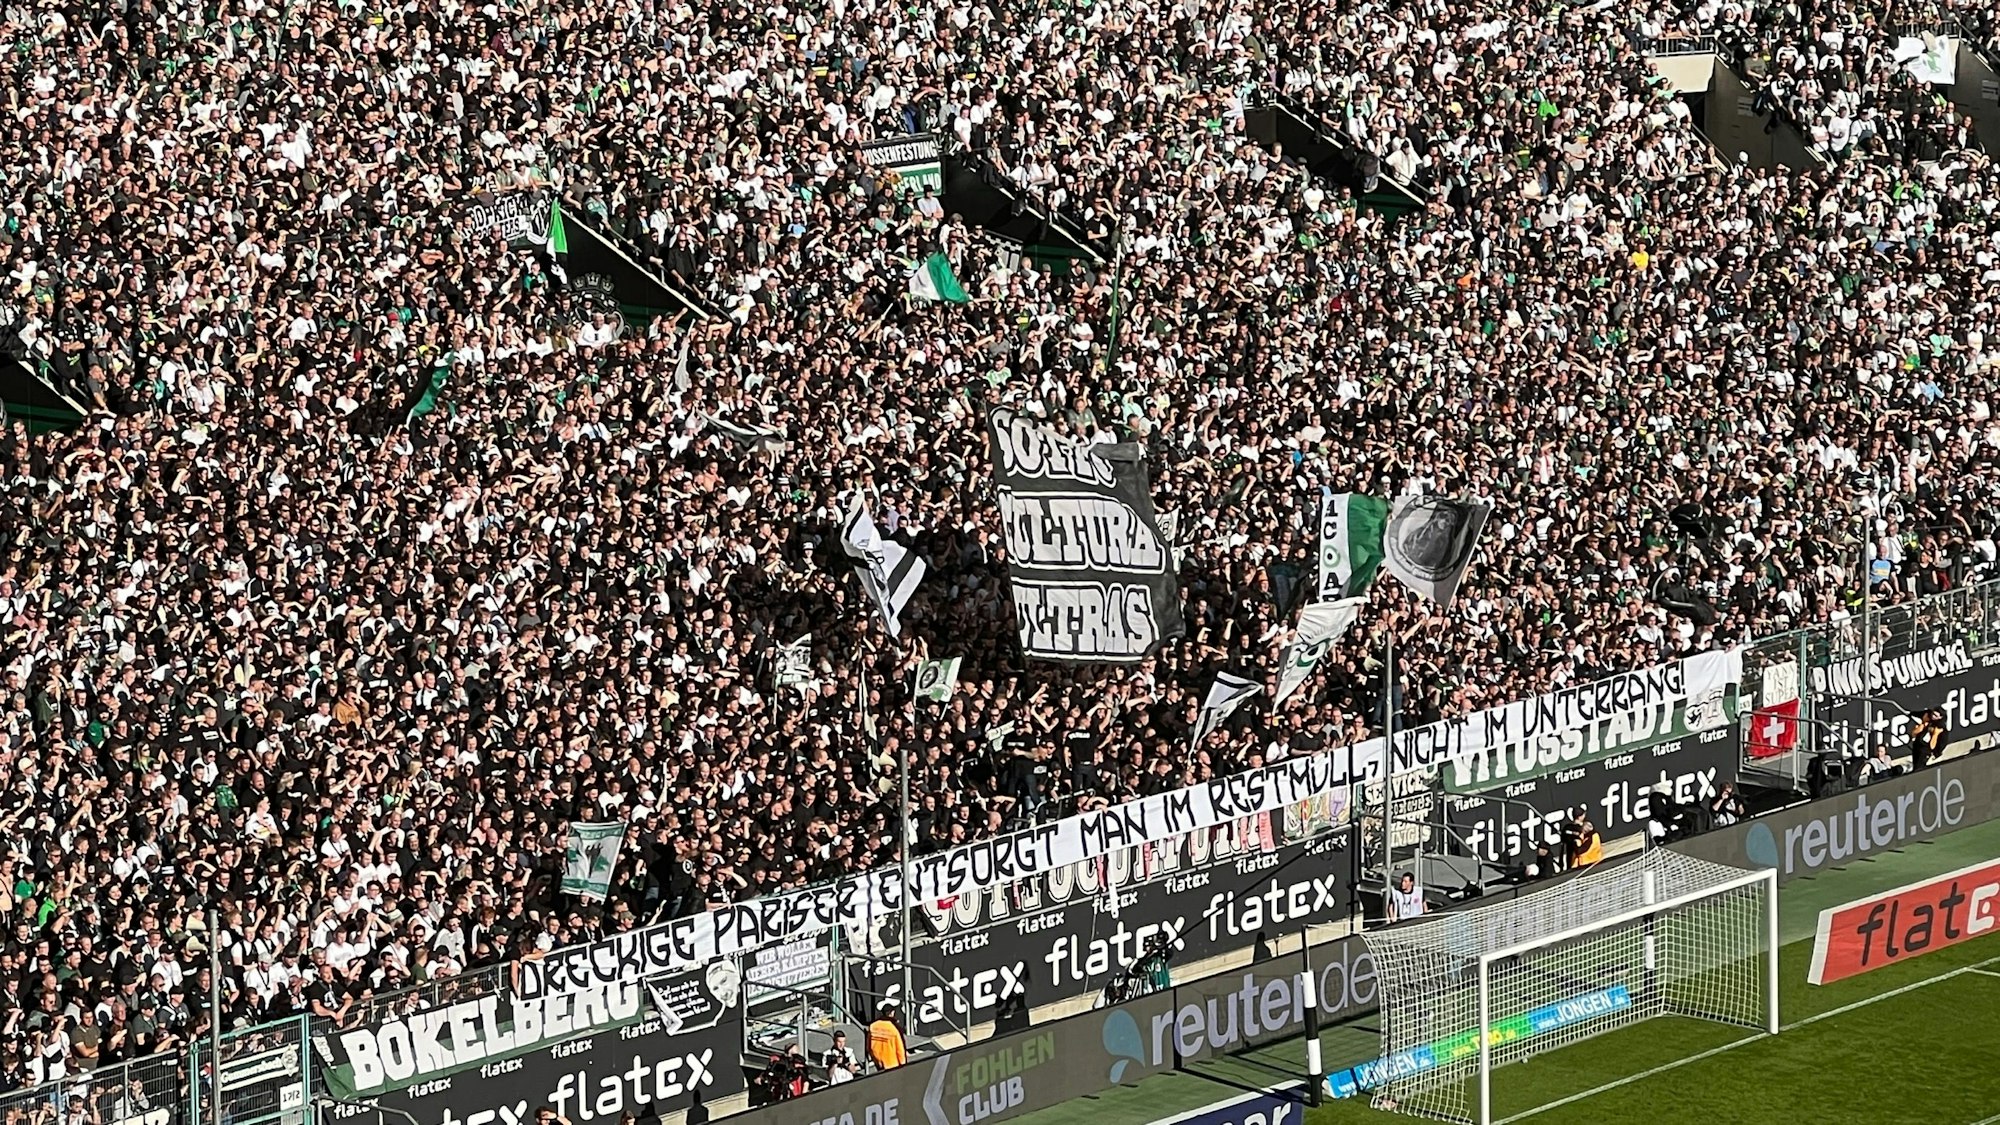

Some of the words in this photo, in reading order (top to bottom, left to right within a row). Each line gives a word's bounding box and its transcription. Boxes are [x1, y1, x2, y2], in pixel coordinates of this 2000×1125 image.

[863, 141, 938, 166] USSENFESTUNG
[1651, 740, 1682, 757] flatex
[1699, 728, 1729, 745] flatex
[1603, 752, 1635, 770] flatex
[1555, 766, 1587, 784] flatex
[1505, 780, 1537, 798] flatex
[520, 917, 696, 1001] DRECKIGE
[712, 876, 858, 955] PARISER
[878, 824, 1059, 909] ENTSORGT
[1080, 801, 1150, 858] MAN
[1162, 789, 1197, 833] IM
[1391, 716, 1470, 774] NICHT
[1483, 706, 1509, 747] IM
[1522, 660, 1687, 738] UNTERRANG!
[1784, 767, 1966, 875] reuter.de
[1235, 853, 1280, 875] flatex
[1164, 872, 1211, 895] flatex
[1202, 873, 1337, 943] flatex
[1017, 911, 1065, 936] flatex
[940, 932, 989, 956] flatex
[619, 1017, 661, 1041] flatex
[550, 1037, 593, 1060] flatex
[479, 1055, 524, 1080] flatex
[955, 1031, 1056, 1095] FOHLEN
[407, 1076, 452, 1100] flatex
[547, 1047, 715, 1121] flatex
[957, 1075, 1026, 1125] CLUB
